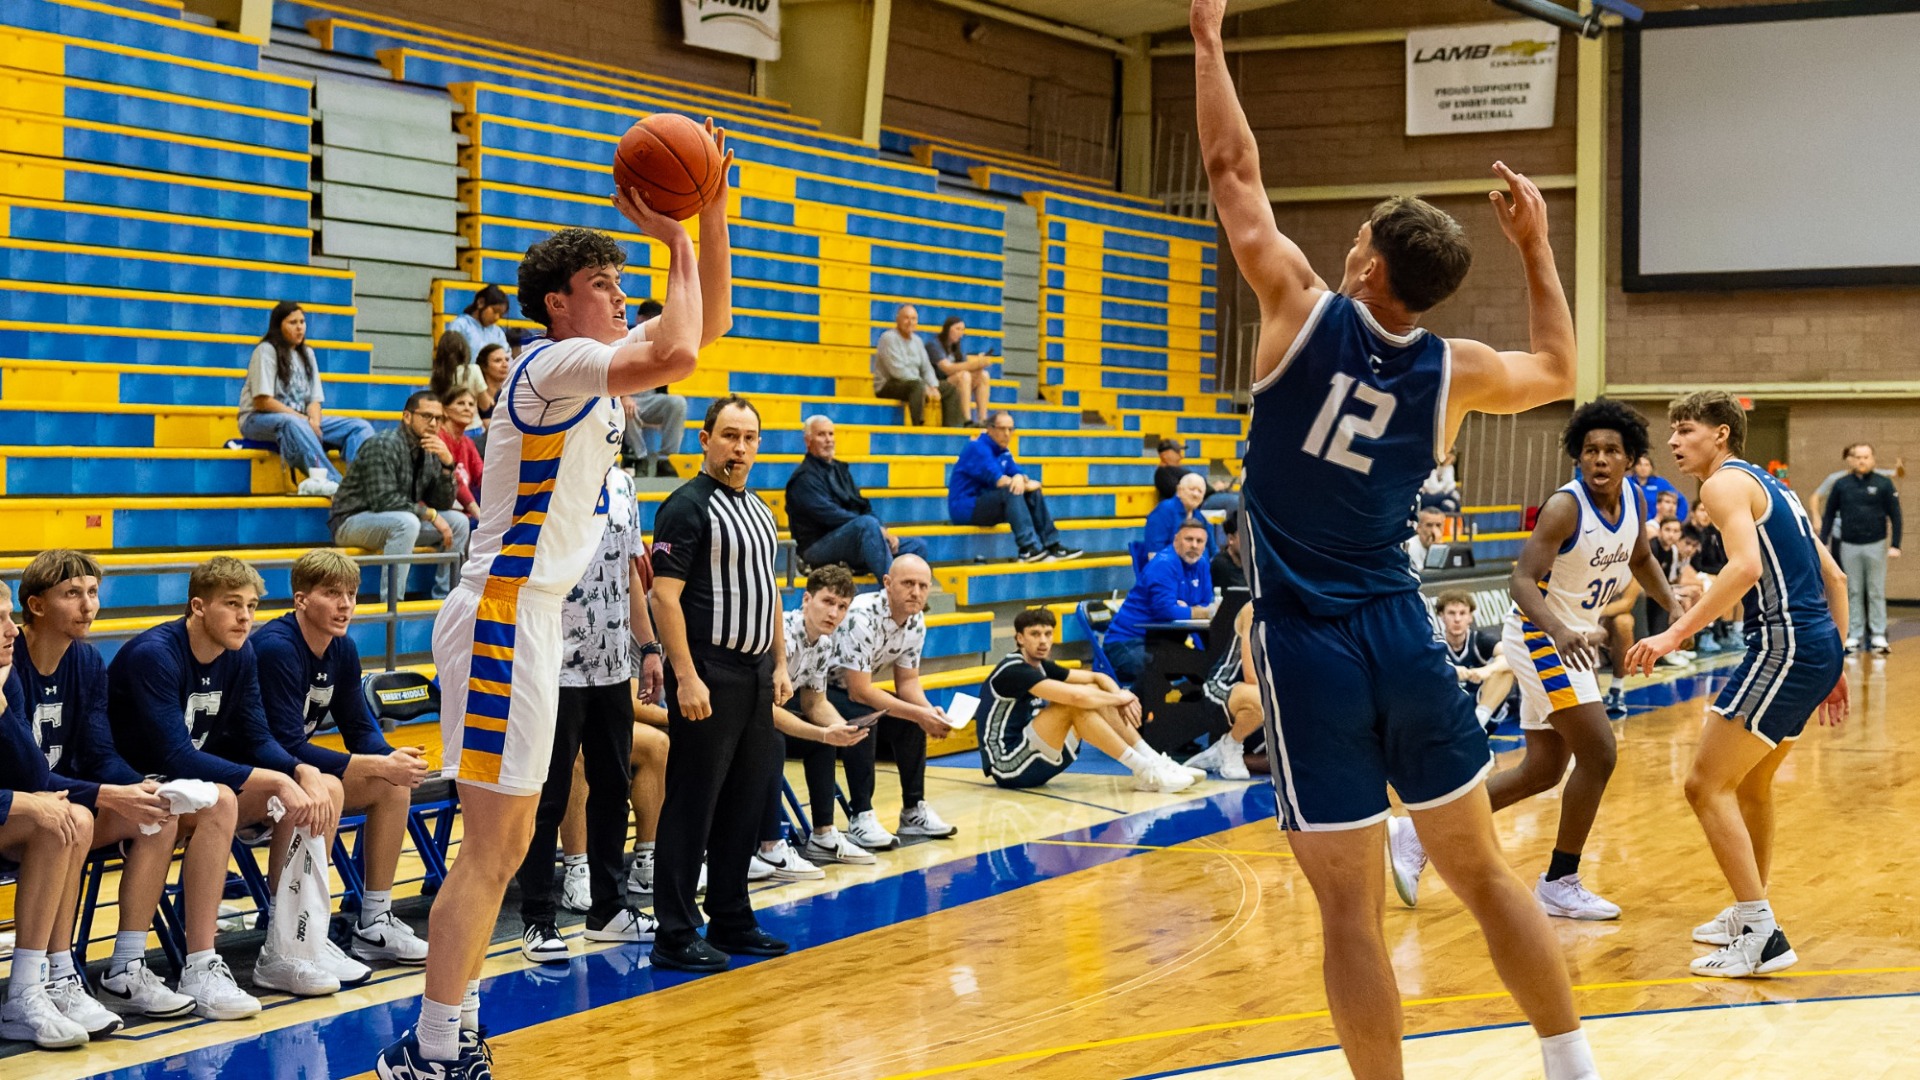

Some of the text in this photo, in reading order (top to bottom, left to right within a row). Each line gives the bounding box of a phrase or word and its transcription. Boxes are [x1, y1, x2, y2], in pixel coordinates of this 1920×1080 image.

[1413, 44, 1492, 64] LAMB
[1434, 82, 1531, 97] PROUD SUPPORTER
[1301, 371, 1397, 476] 12
[1589, 542, 1629, 572] Eagles
[1581, 576, 1618, 610] 30
